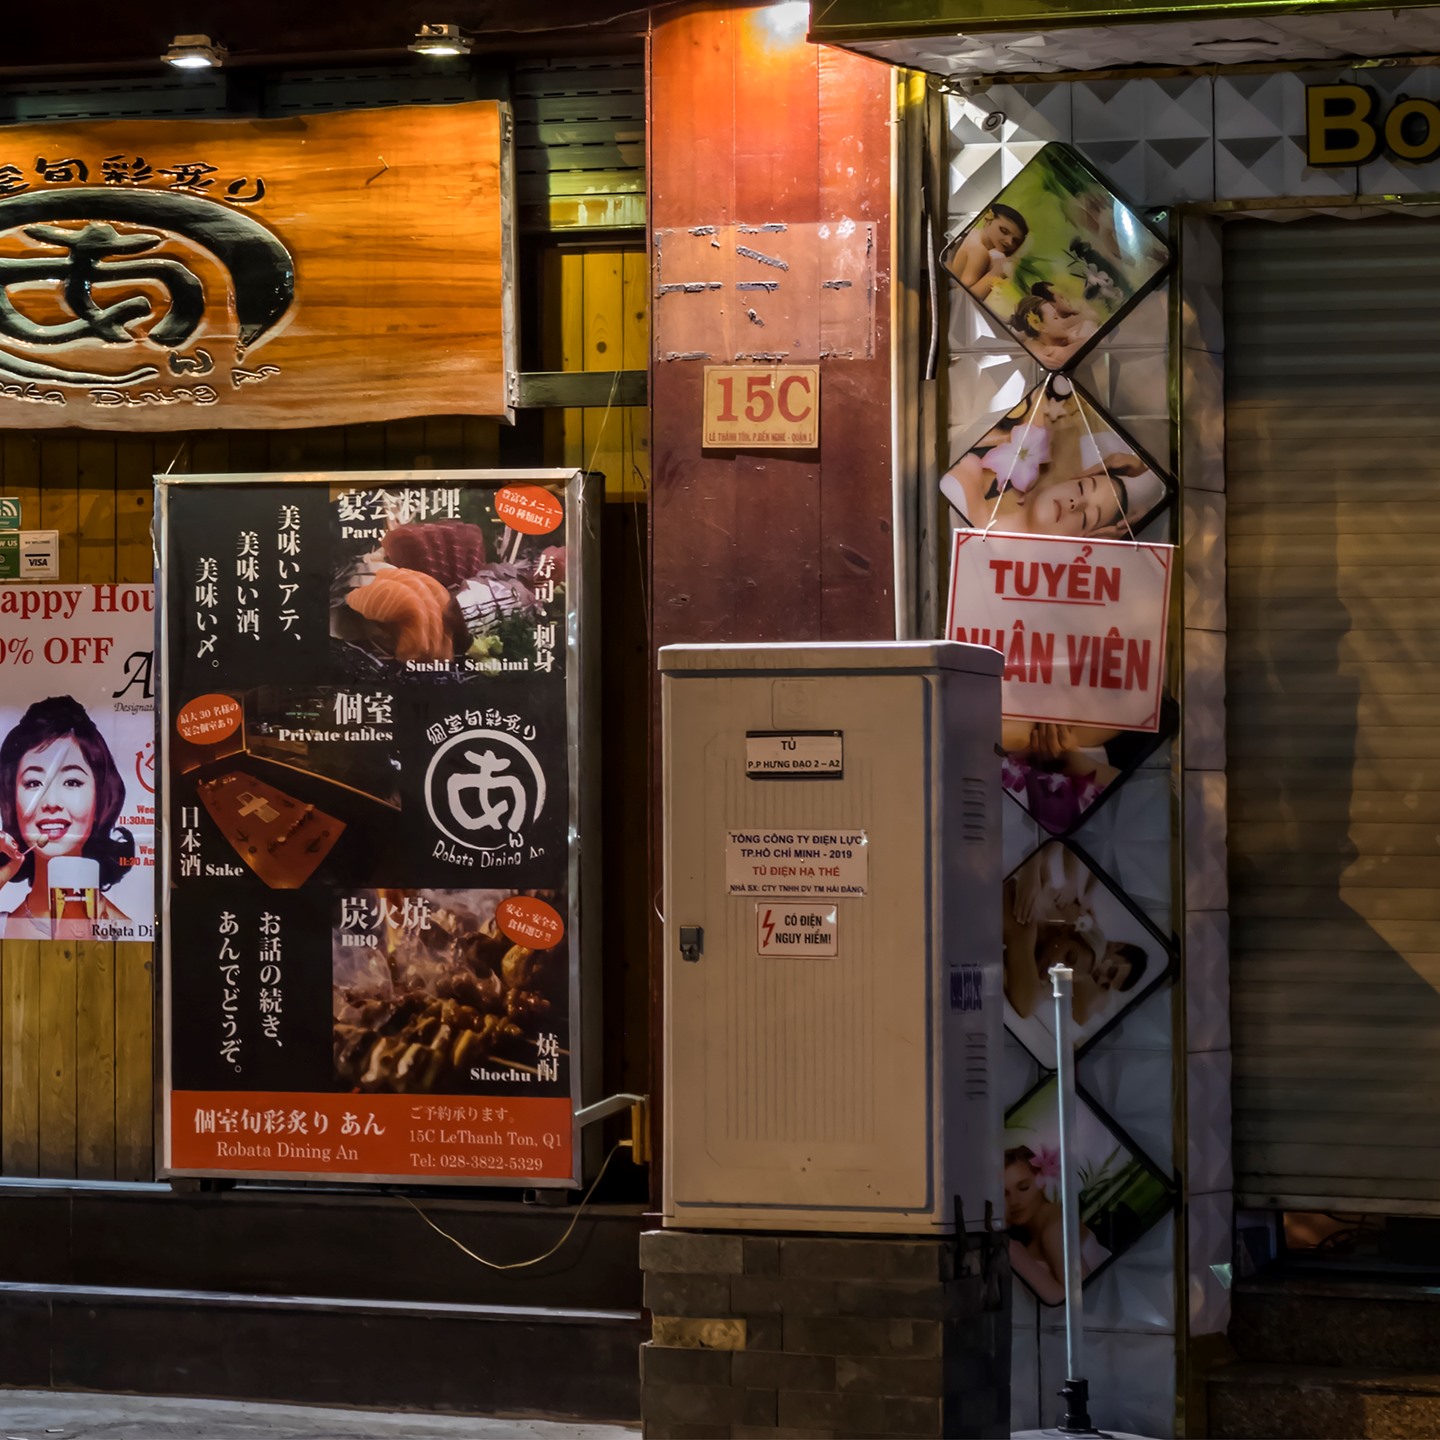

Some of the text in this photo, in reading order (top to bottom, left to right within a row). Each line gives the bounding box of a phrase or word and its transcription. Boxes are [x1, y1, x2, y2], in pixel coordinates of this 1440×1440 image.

[1304, 83, 1440, 168] Bo
[87, 384, 220, 408] Dining
[230, 363, 282, 392] An
[716, 373, 812, 423] 15C
[337, 487, 461, 522] 宴会料理
[341, 526, 390, 542] Party
[28, 559, 48, 567] VISA
[989, 545, 1122, 602] TUYỂN
[43, 636, 115, 665] OFF
[956, 619, 1152, 692] ÂN VIÊN
[406, 658, 529, 672] Sushi Sashimi
[333, 691, 394, 725] 個室
[278, 728, 394, 742] Private tables
[813, 760, 820, 769] 2
[828, 760, 841, 769] A2
[180, 806, 202, 877] 日本酒
[796, 834, 810, 844] TY
[812, 834, 838, 846] ĐIỆN
[432, 839, 545, 868] Robata Dining An
[794, 849, 820, 858] MINH
[829, 850, 853, 859] 2019
[205, 863, 244, 877] Sake
[770, 866, 797, 878] ĐIỆN
[761, 884, 777, 892] CTY
[779, 884, 800, 893] TNHH
[814, 885, 825, 893] TM
[339, 896, 433, 931] 炭火焼
[784, 912, 823, 929] CÓ ĐIỆN
[91, 923, 135, 939] Robata
[775, 933, 802, 945] NGUY
[341, 934, 379, 950] BBQ
[259, 911, 283, 1048] お話の続き、
[218, 911, 243, 1073] あんでどうぞ。
[536, 1032, 560, 1083] 焼酎
[470, 1066, 532, 1082] Shochu
[194, 1108, 386, 1136] 個室旬彩炙り あん
[410, 1130, 436, 1144] 15C
[506, 1131, 539, 1148] Ton,
[542, 1132, 562, 1149] Q1
[216, 1141, 359, 1163] Robata Dining An
[410, 1153, 544, 1171] Tel: 028-3822-5329
